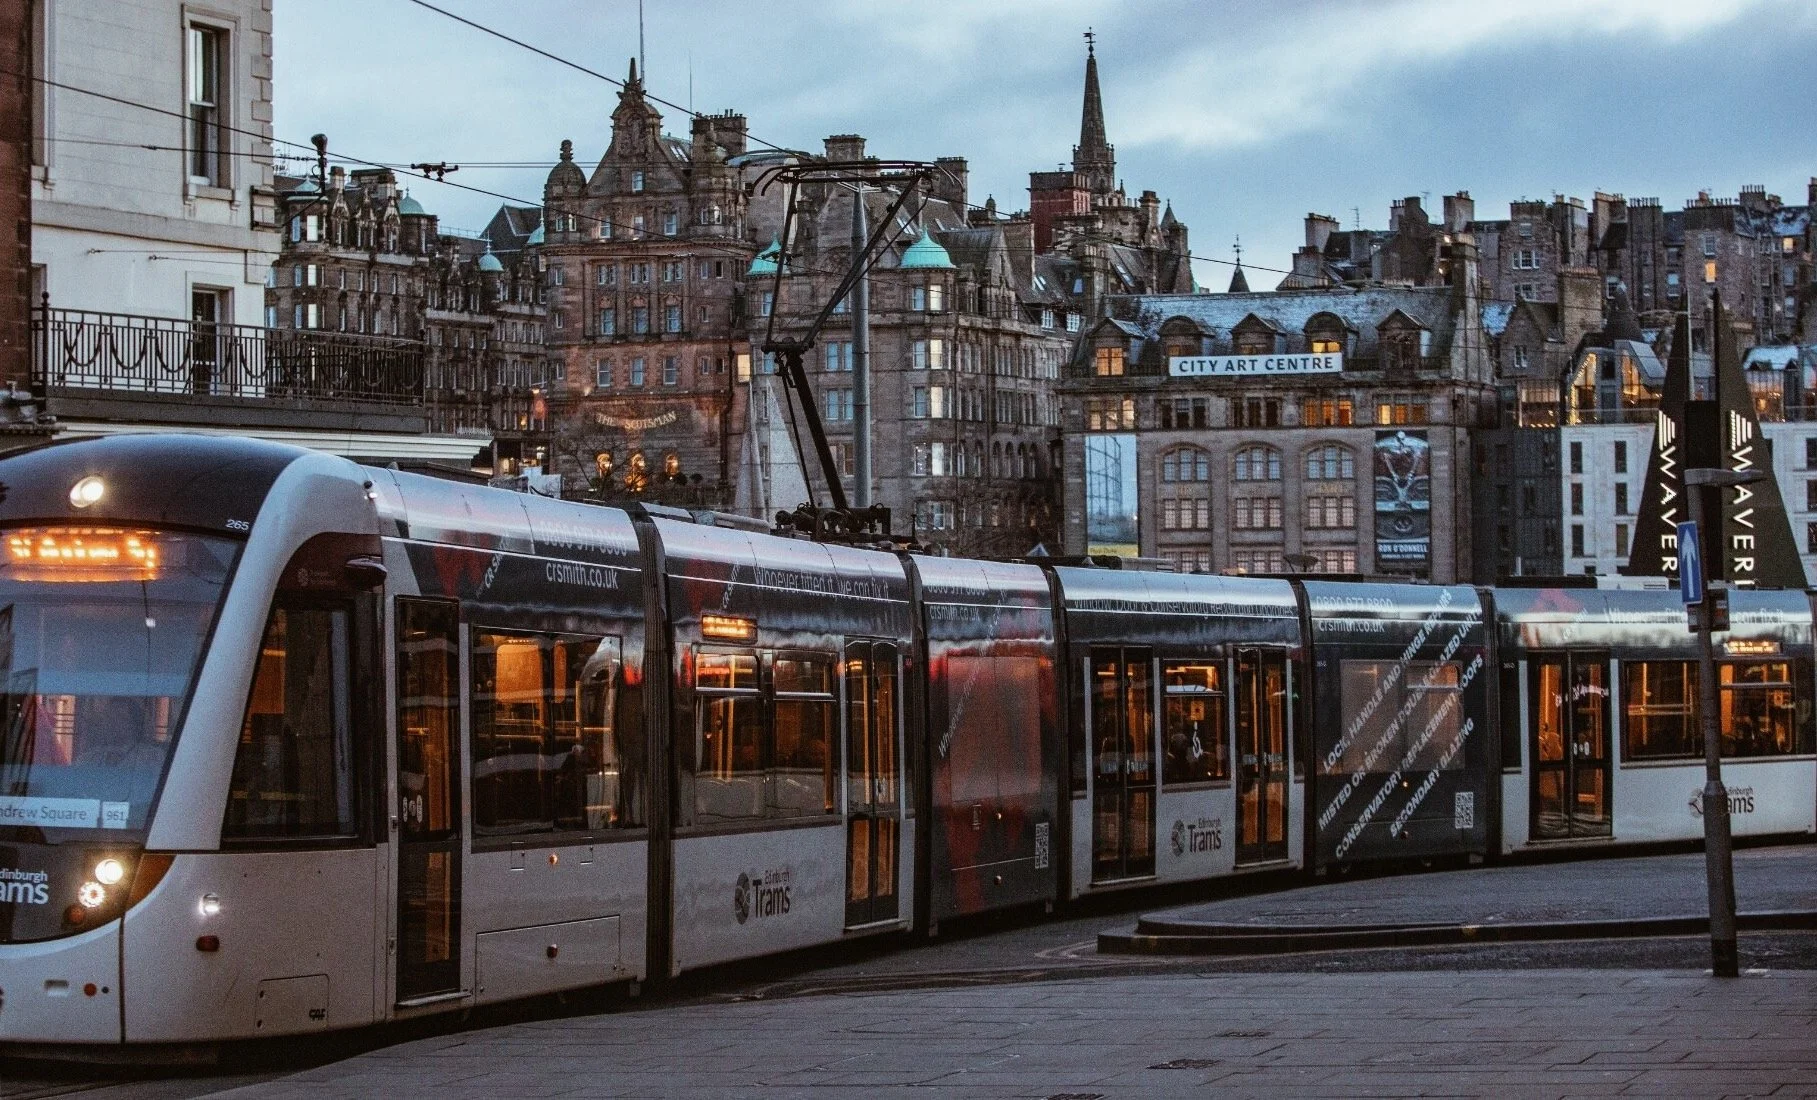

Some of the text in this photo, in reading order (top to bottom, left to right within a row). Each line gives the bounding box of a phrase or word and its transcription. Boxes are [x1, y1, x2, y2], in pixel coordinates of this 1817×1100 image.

[1179, 356, 1333, 373] CITY ART CENTRE
[625, 410, 677, 430] SCOTSMAN
[225, 519, 250, 531] 265
[546, 561, 618, 590] crsmith.co.uk
[1319, 618, 1385, 633] crsmith.co.uk
[1348, 688, 1384, 739] HANDLE
[1382, 664, 1402, 694] AND
[1400, 629, 1427, 668] HINGE
[1318, 782, 1353, 831] MISTED
[1351, 765, 1367, 788] OR
[1364, 718, 1400, 771] BROKEN
[1335, 767, 1402, 859] CONSERVATORY
[1401, 691, 1458, 771] REPLACEMENT
[1390, 716, 1475, 839] SECONDARY GLAZING
[40, 806, 87, 822] Square
[106, 810, 124, 821] 961
[1187, 824, 1222, 853] Trams
[752, 879, 791, 918] Trams
